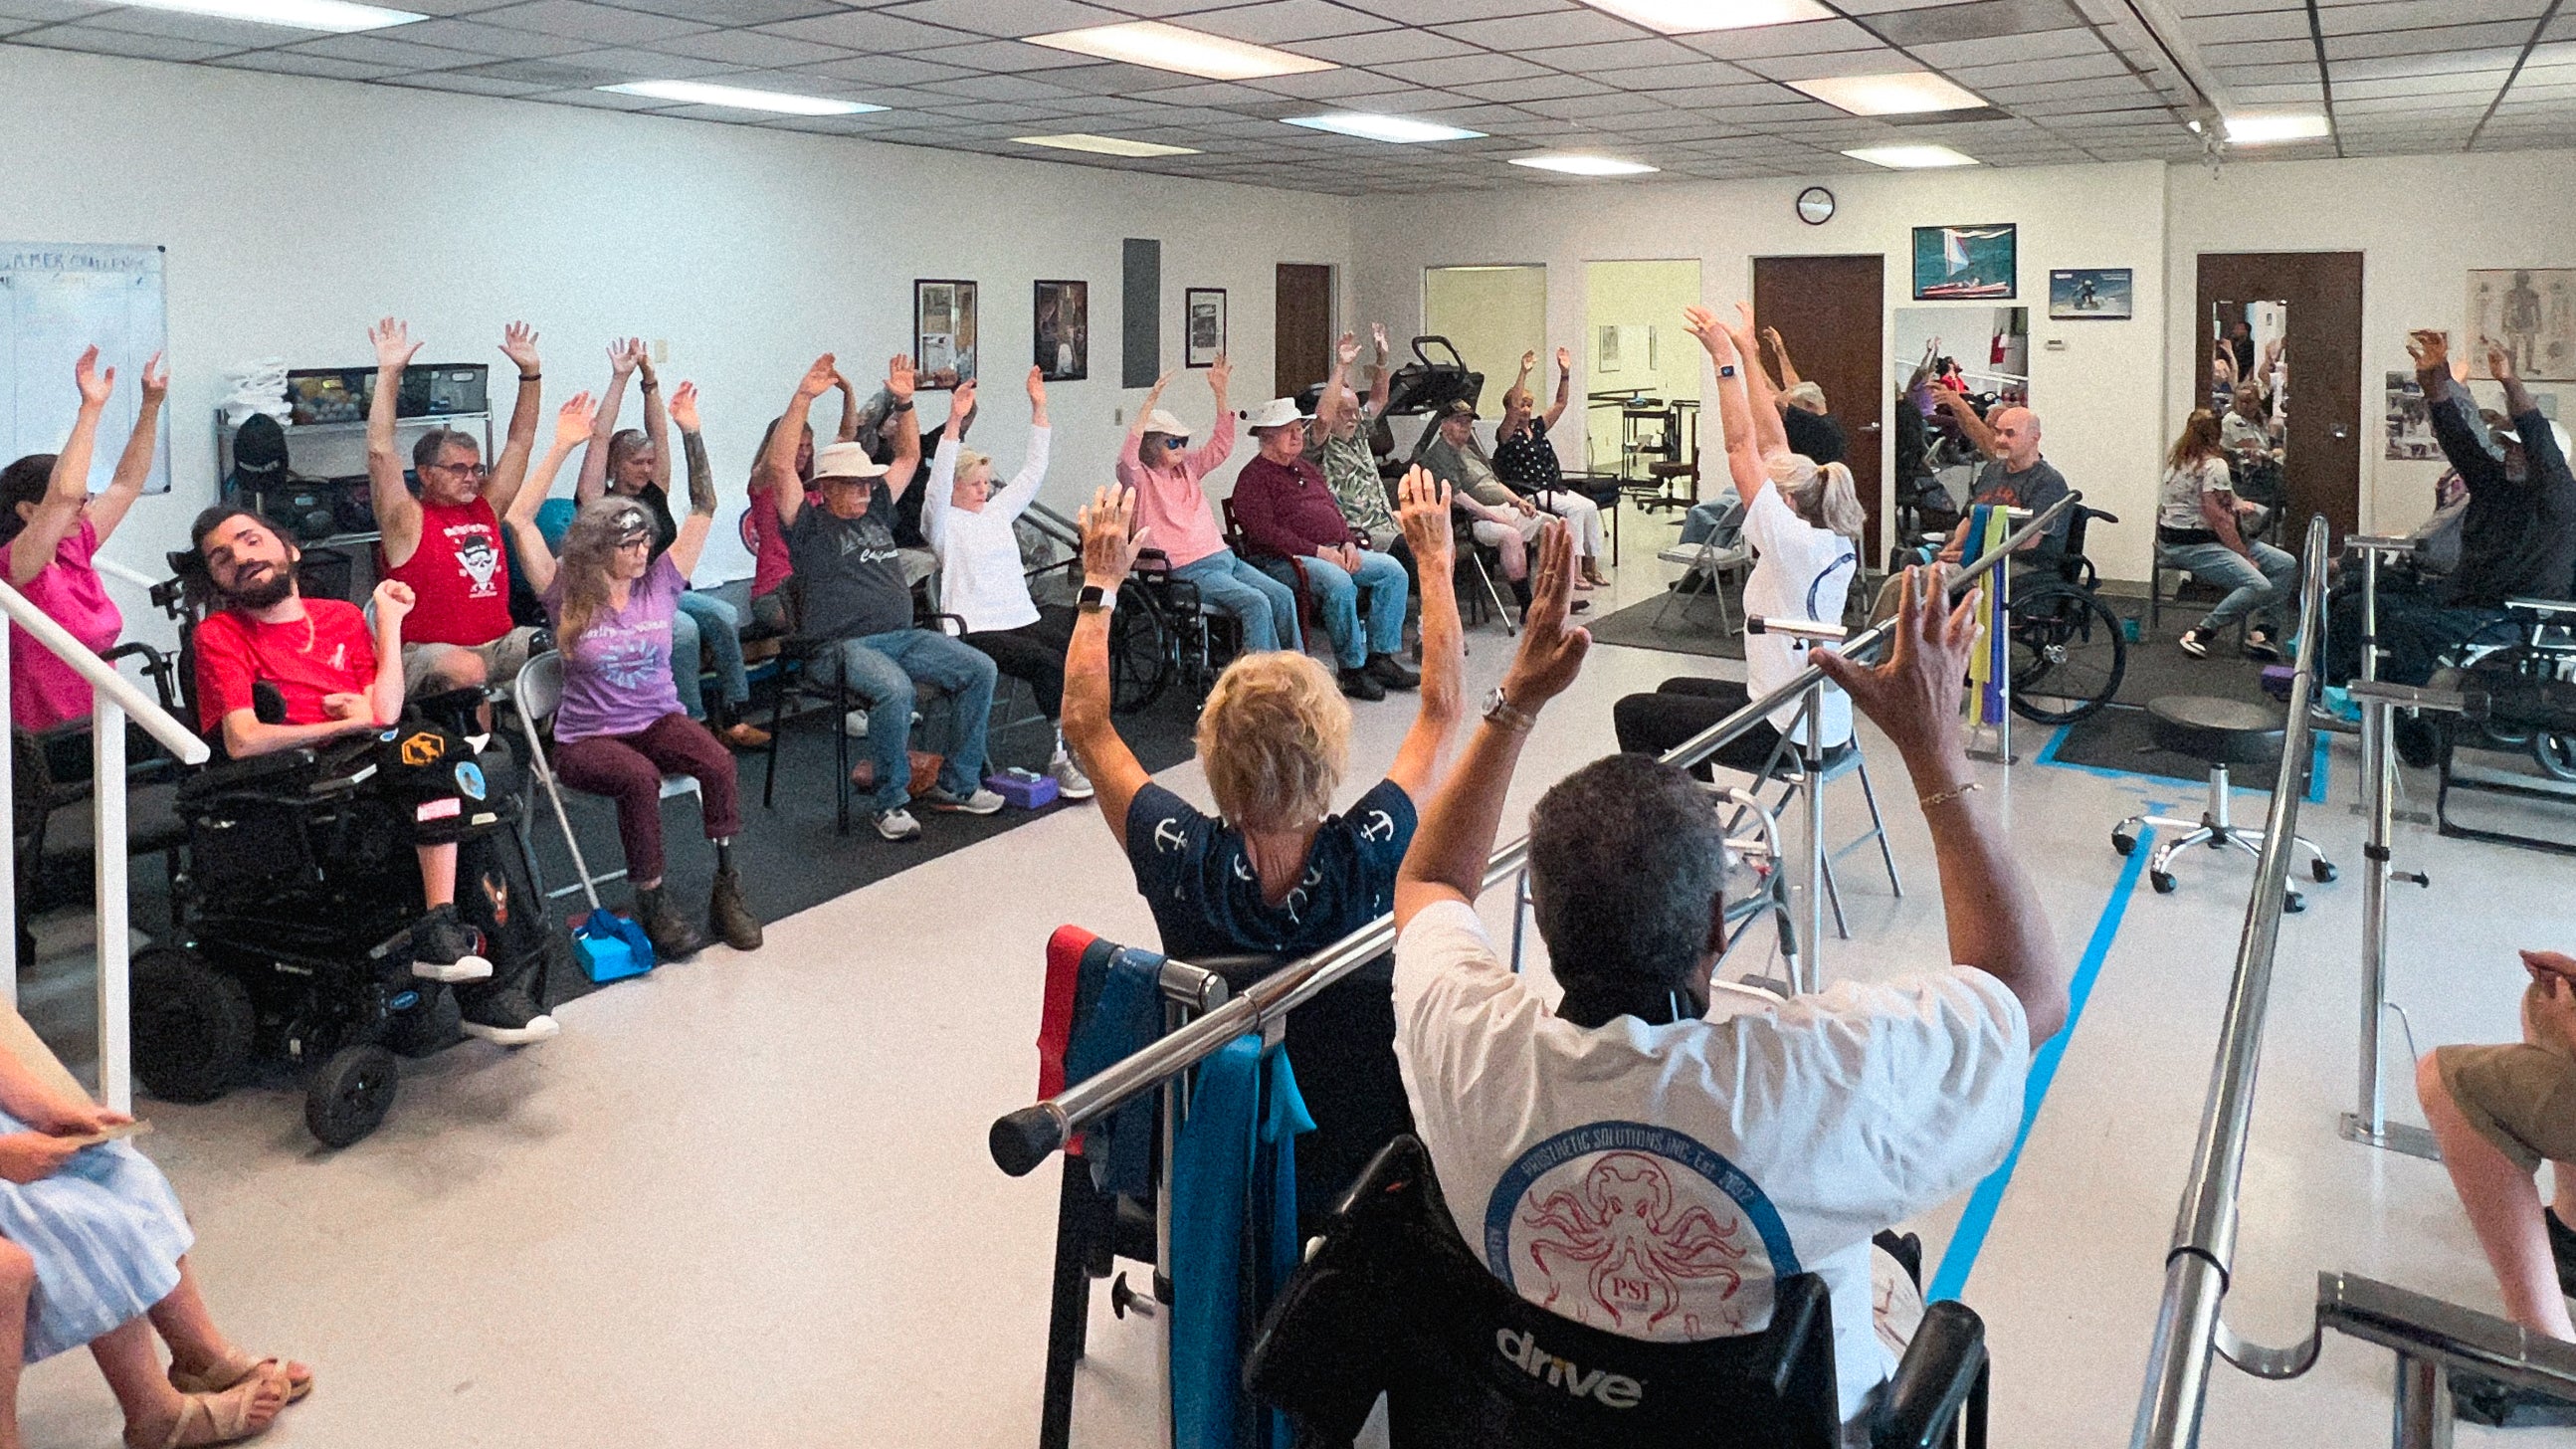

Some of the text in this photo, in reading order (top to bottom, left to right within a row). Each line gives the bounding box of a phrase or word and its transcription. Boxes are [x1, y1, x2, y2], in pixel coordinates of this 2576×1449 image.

[1520, 1132, 1591, 1176] PROSTHETIC
[1612, 1277, 1650, 1302] PSI
[1495, 1328, 1643, 1409] drive
